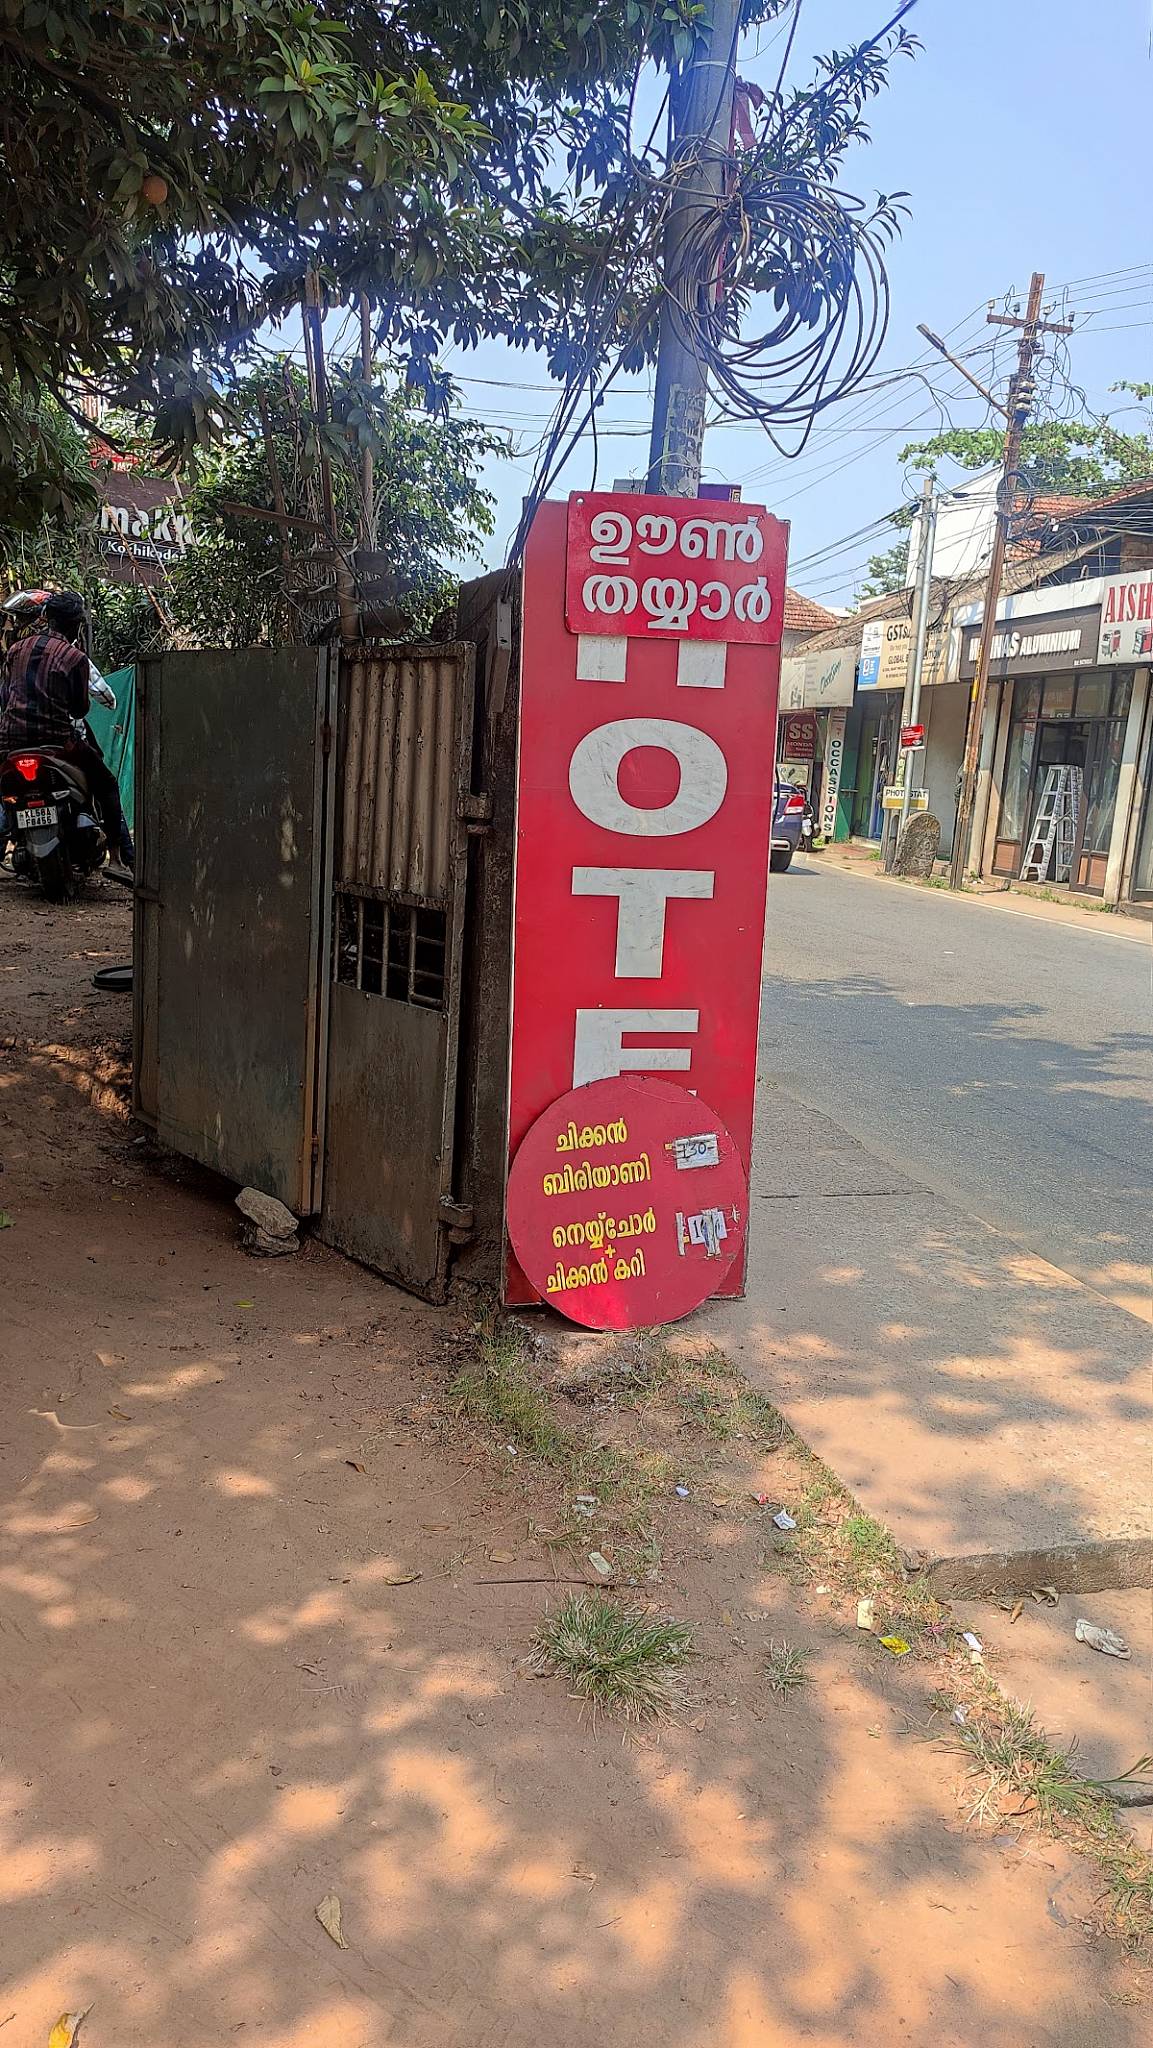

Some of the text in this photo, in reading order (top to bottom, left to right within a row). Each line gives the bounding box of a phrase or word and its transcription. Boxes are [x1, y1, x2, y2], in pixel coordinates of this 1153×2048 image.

[589, 511, 764, 566] ഊൺ
[581, 574, 772, 631] തയ്യാർ
[1019, 629, 1082, 656] ALUMINIUM
[788, 723, 814, 740] SS
[823, 740, 842, 832] OCCASSIONS
[885, 788, 928, 799] PHOTSTAT
[555, 1117, 628, 1152] ചിക്കൻ
[543, 1152, 652, 1196] ബിരിയാണി
[546, 1248, 646, 1293] ചിക്കൻ കറി
